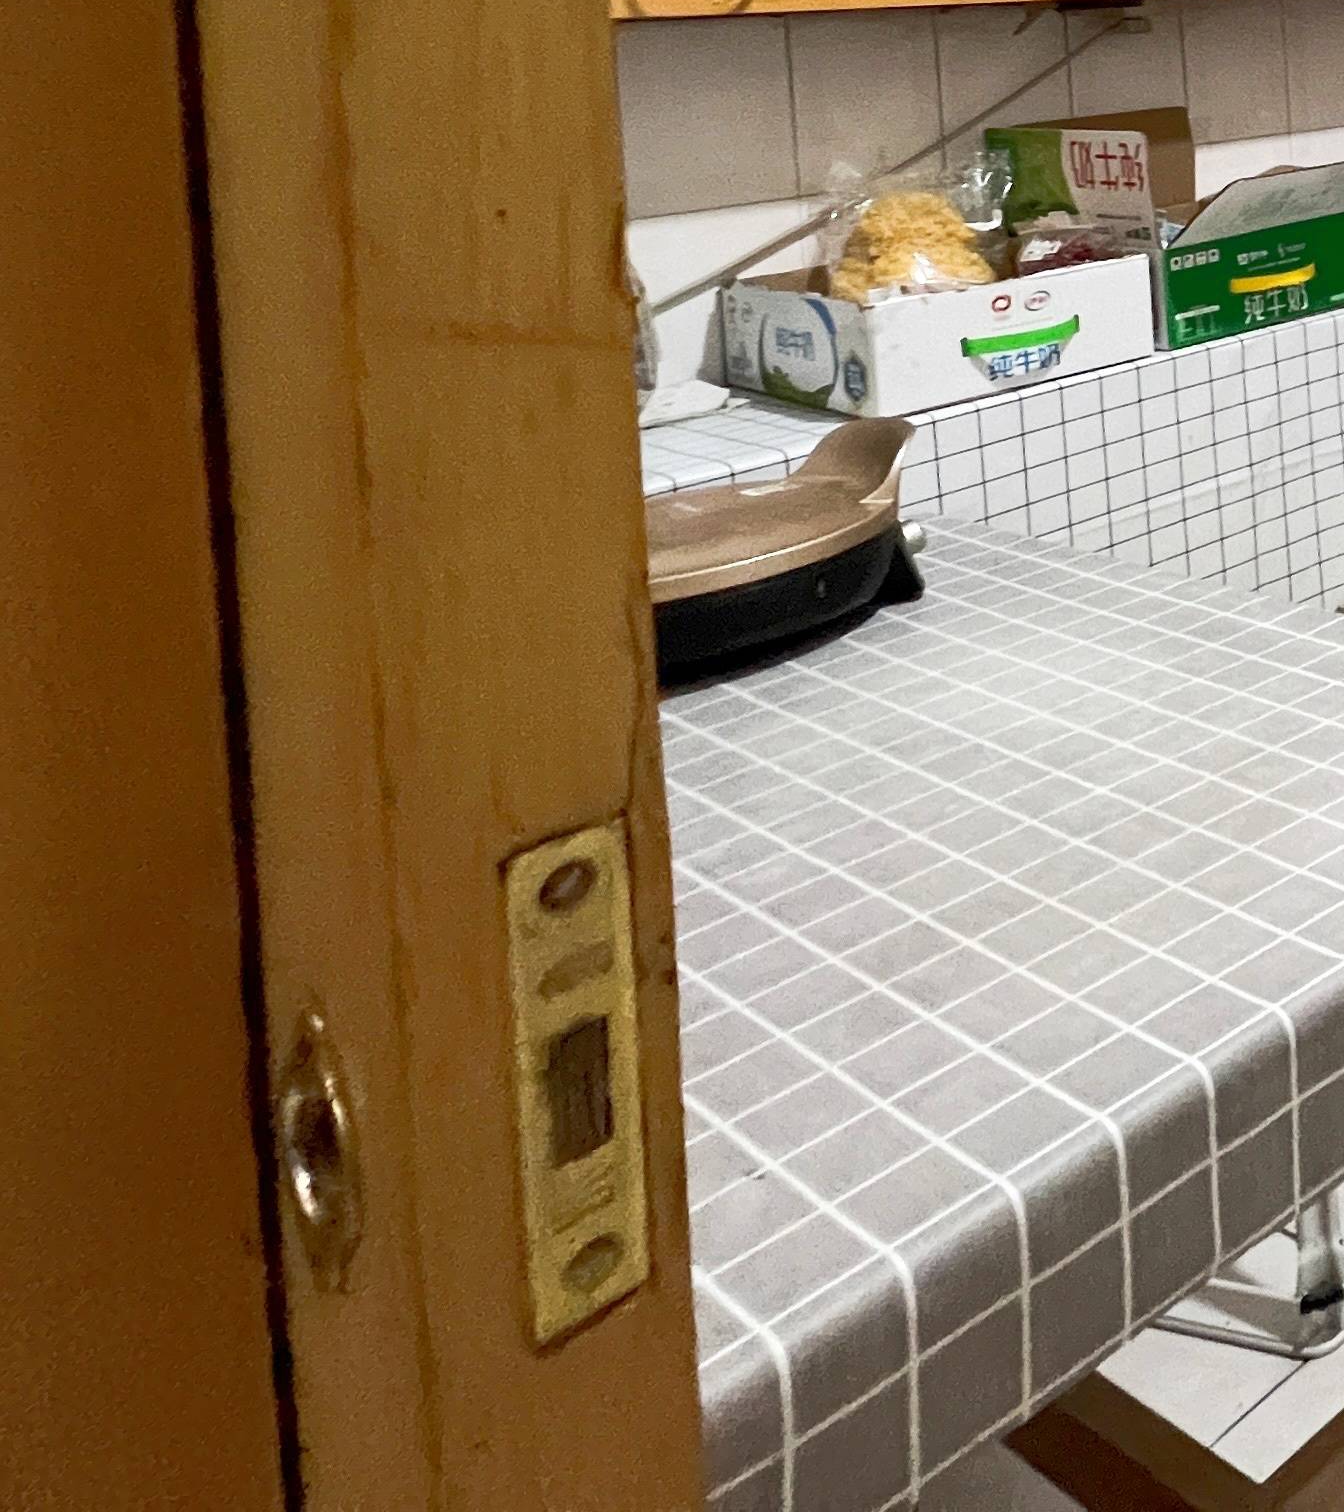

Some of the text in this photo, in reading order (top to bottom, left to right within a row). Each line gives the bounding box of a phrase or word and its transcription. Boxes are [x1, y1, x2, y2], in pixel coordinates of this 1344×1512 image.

[1243, 282, 1310, 325] 纯牛奶
[988, 343, 1062, 381] 纯牛奶
